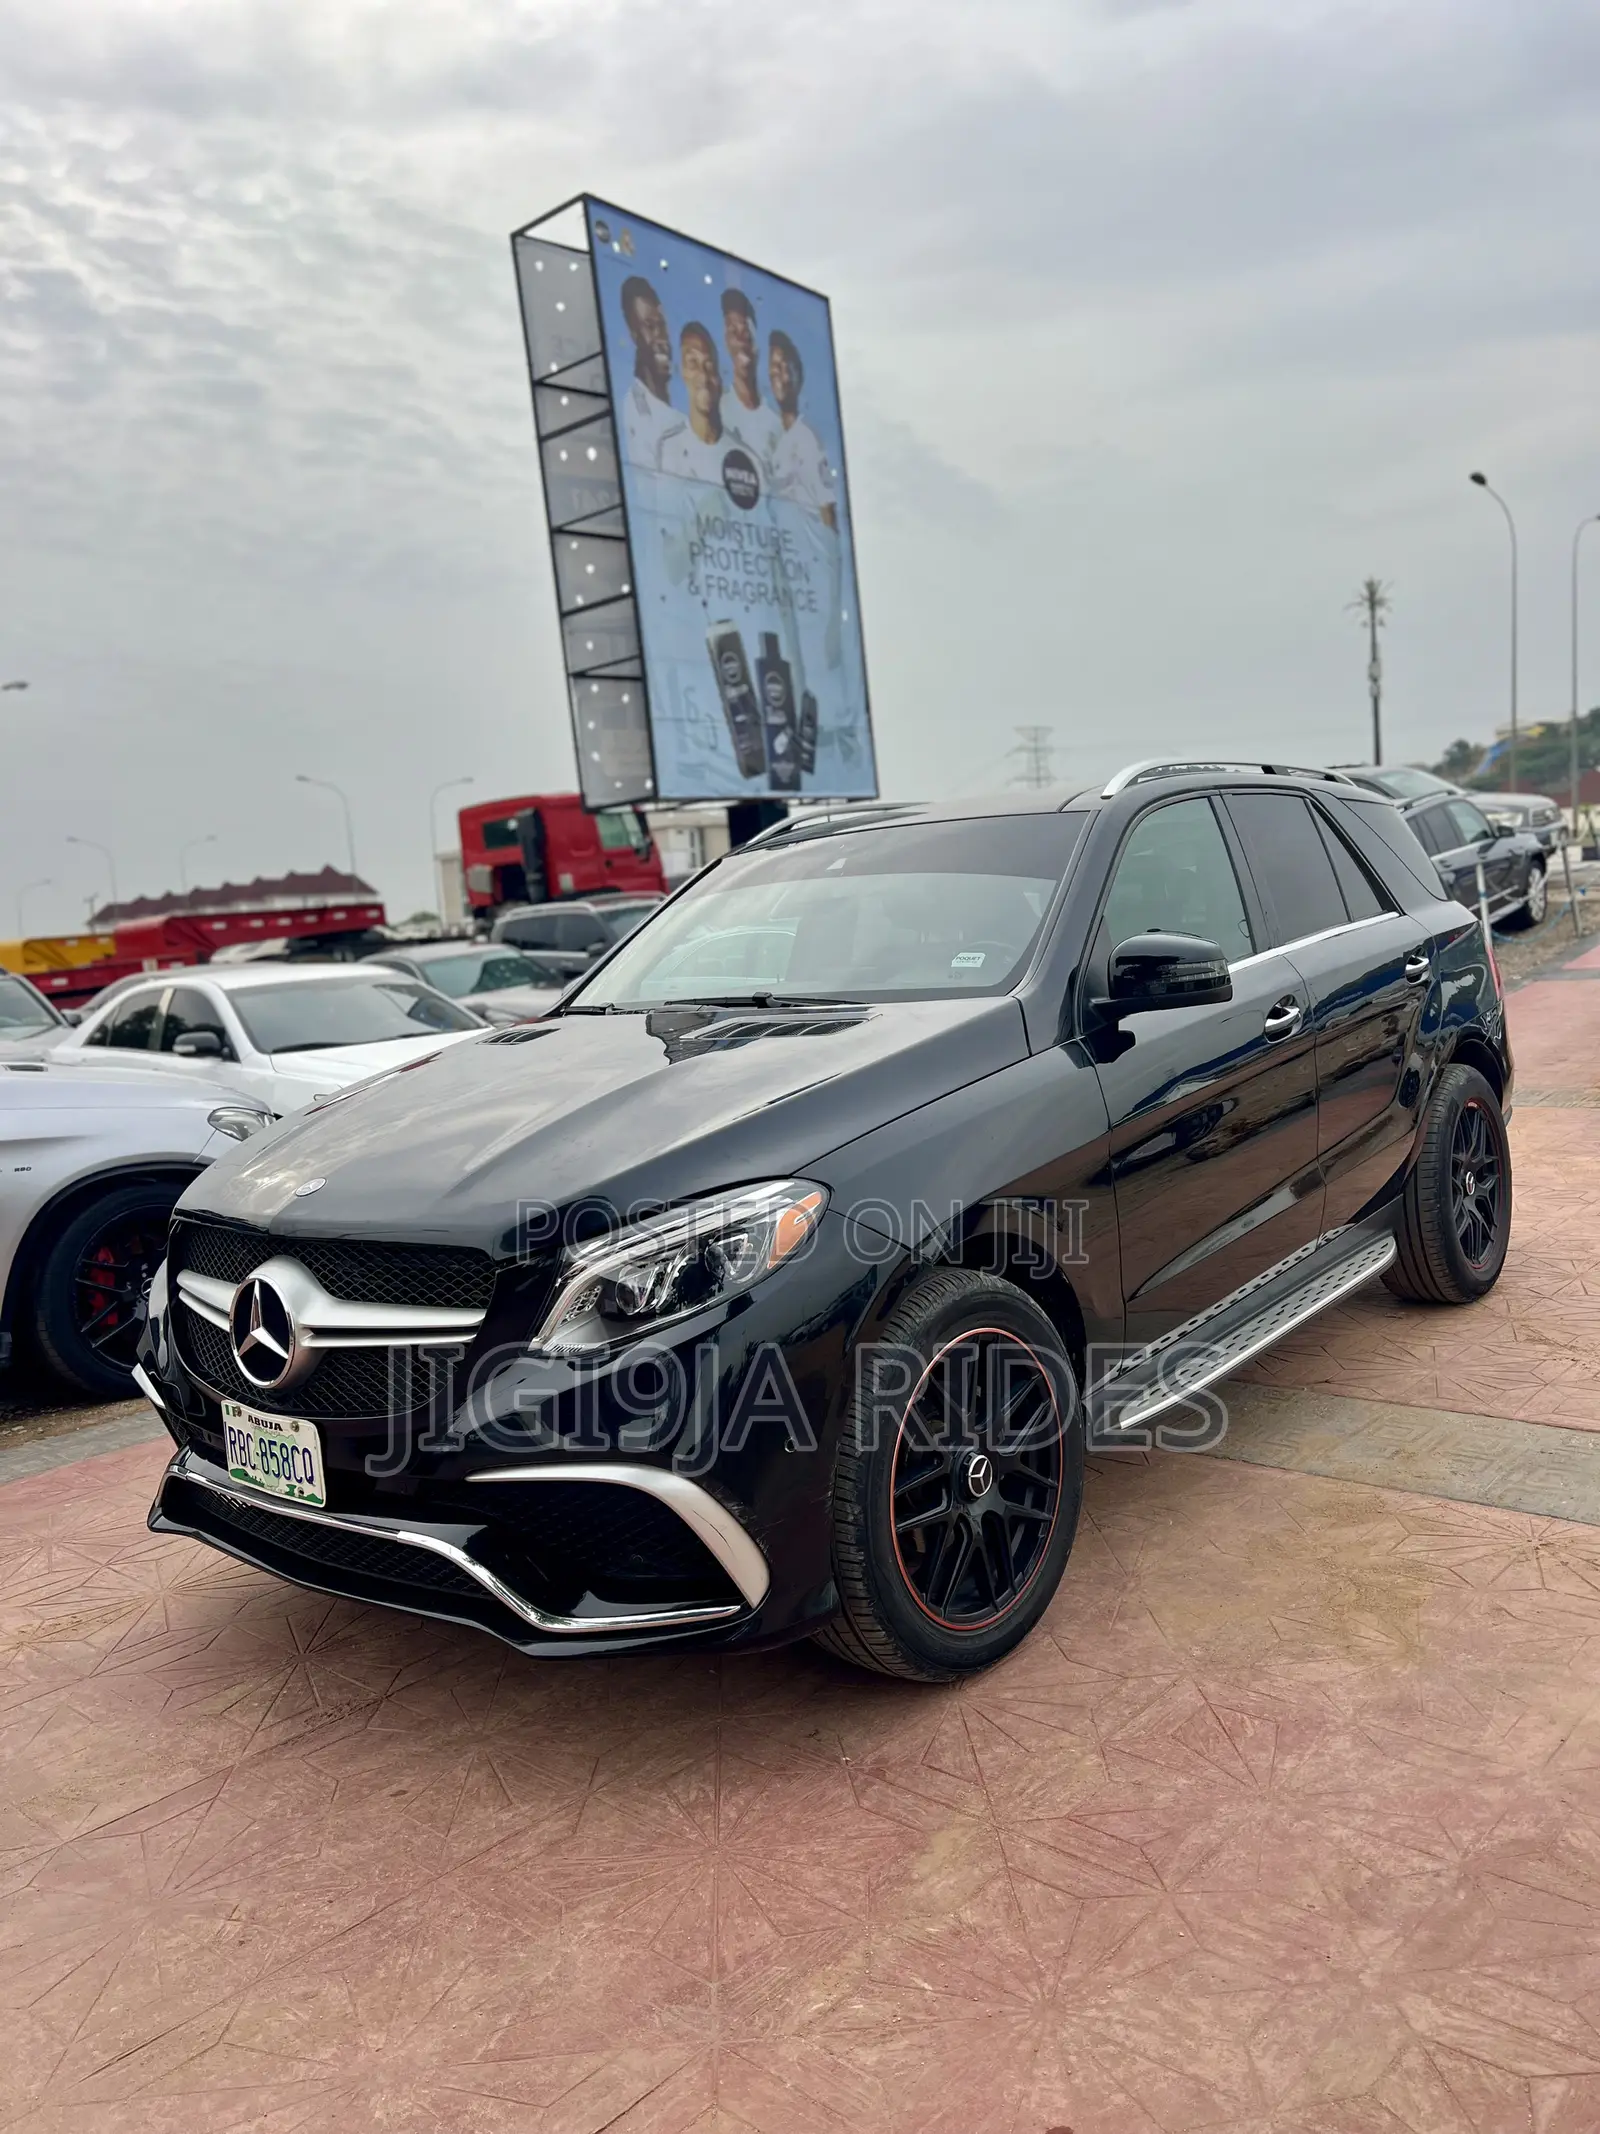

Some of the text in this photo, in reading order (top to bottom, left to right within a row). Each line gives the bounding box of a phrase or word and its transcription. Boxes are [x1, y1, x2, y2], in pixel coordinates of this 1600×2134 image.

[696, 512, 796, 553] MOISTURE
[688, 541, 811, 584] PROTECTION
[688, 572, 818, 613] & FRAGRANCE
[247, 1414, 284, 1432] ABUJA
